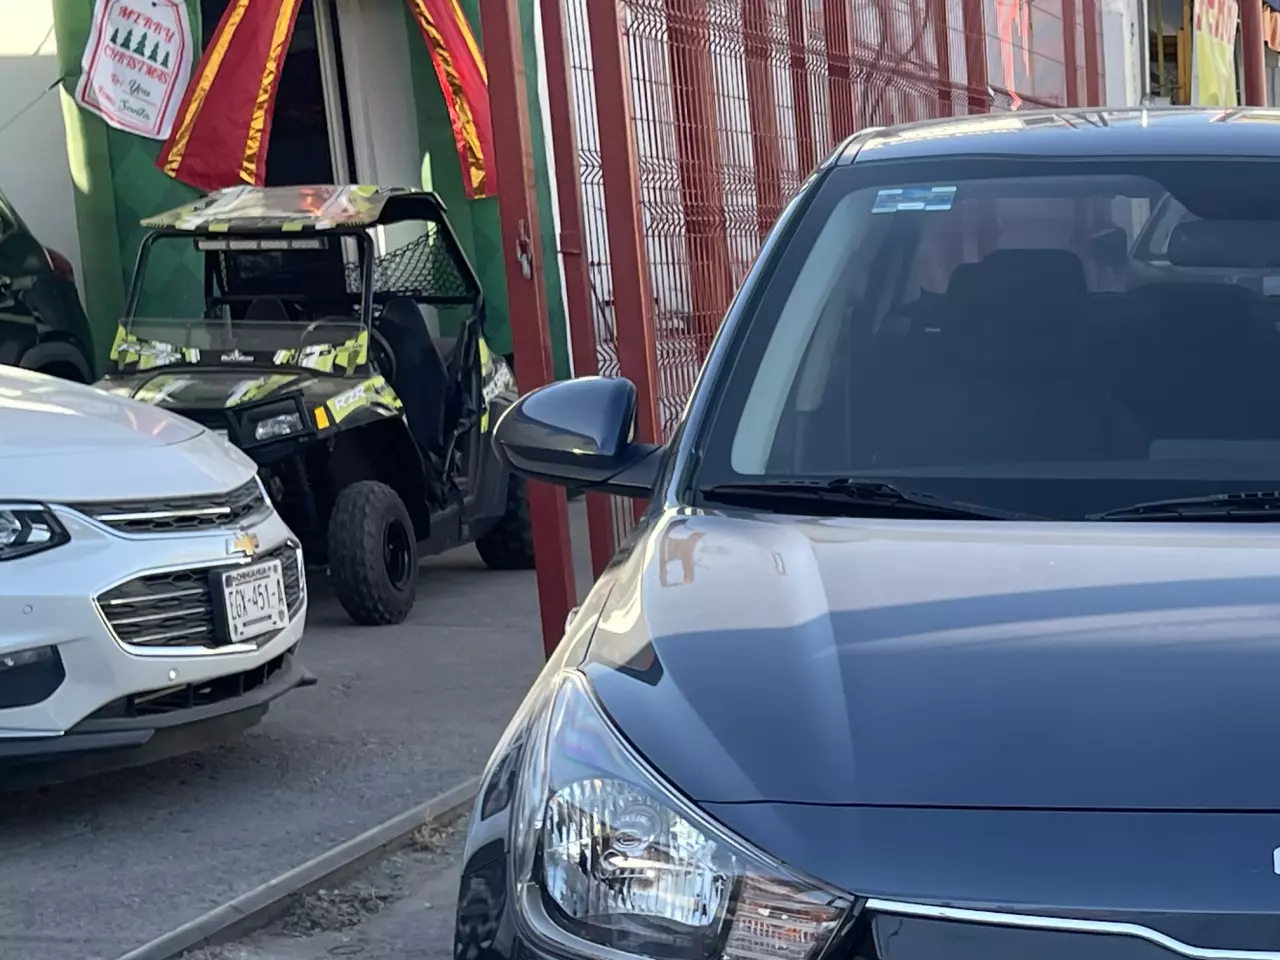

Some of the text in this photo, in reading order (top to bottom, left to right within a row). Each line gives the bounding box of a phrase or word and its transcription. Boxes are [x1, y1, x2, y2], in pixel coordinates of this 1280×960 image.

[118, 5, 175, 43] MERRY
[103, 44, 170, 84] CHRISTMAS
[128, 79, 151, 98] You
